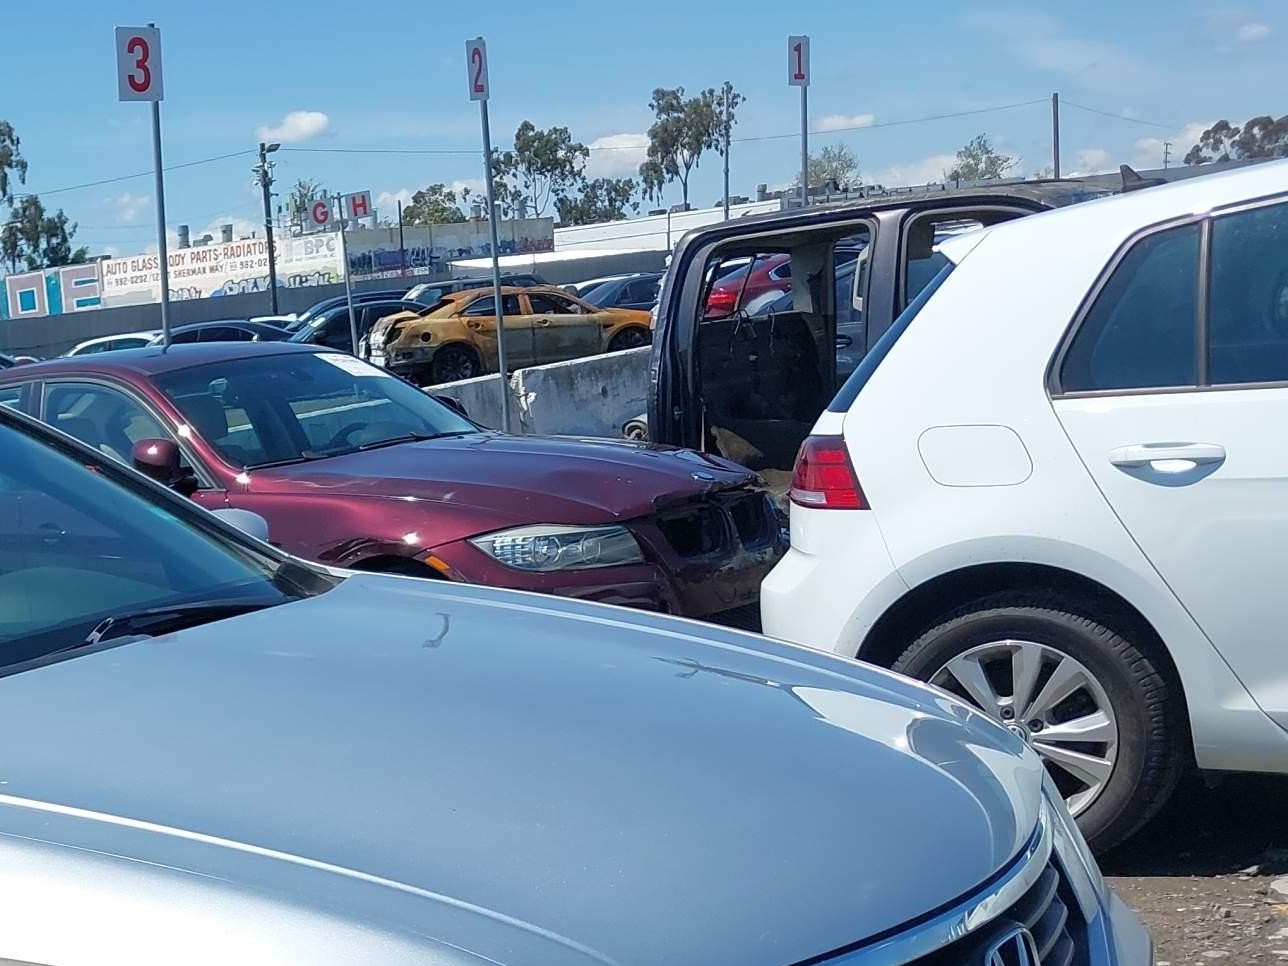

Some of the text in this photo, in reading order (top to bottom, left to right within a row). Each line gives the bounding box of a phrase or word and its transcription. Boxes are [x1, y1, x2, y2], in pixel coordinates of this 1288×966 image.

[127, 36, 151, 93] 3
[471, 47, 485, 93] 2
[793, 41, 806, 81] 1
[312, 202, 329, 225] G
[351, 194, 368, 217] H
[303, 236, 336, 256] BPC
[105, 260, 128, 277] AUTO
[130, 256, 159, 272] GLASS
[168, 252, 186, 268] ODY
[174, 266, 206, 279] SHERMAN
